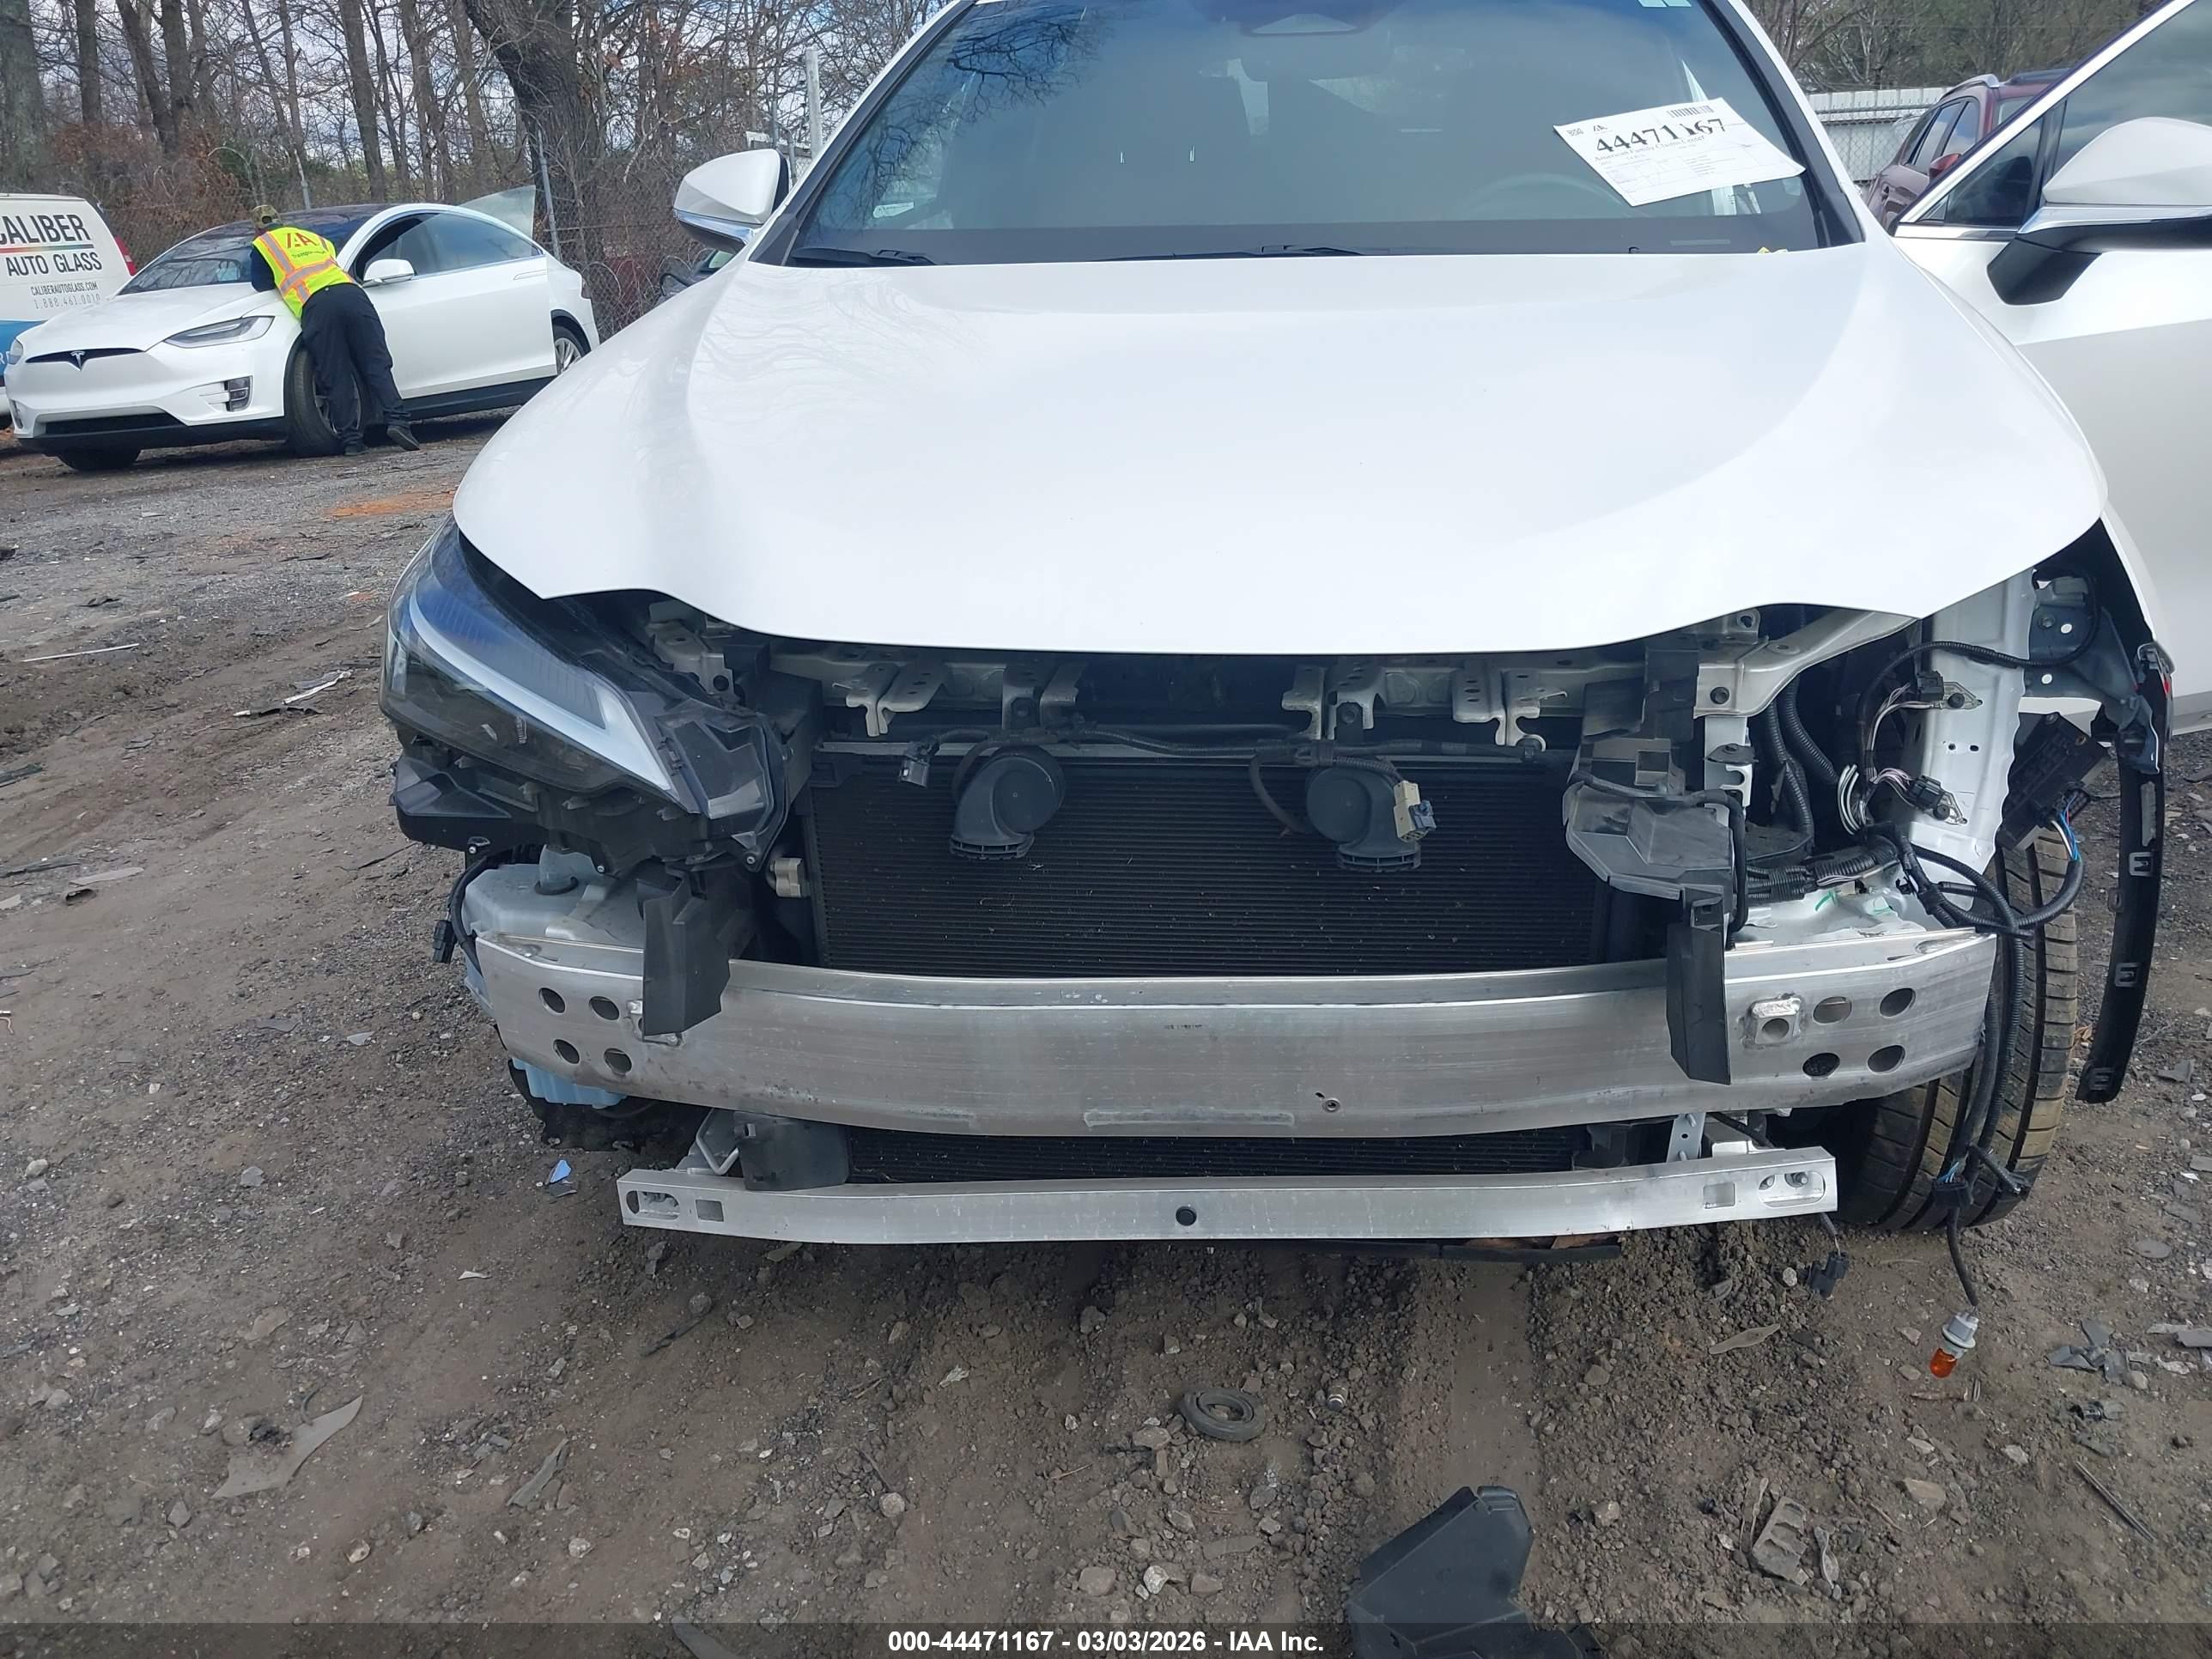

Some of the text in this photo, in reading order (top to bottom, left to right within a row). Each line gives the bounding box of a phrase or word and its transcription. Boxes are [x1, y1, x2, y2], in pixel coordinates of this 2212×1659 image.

[1596, 118, 1726, 152] 44471167
[5, 252, 103, 276] AUTO GLASS
[30, 281, 100, 296] CALIBERAUTOGLASS.COM
